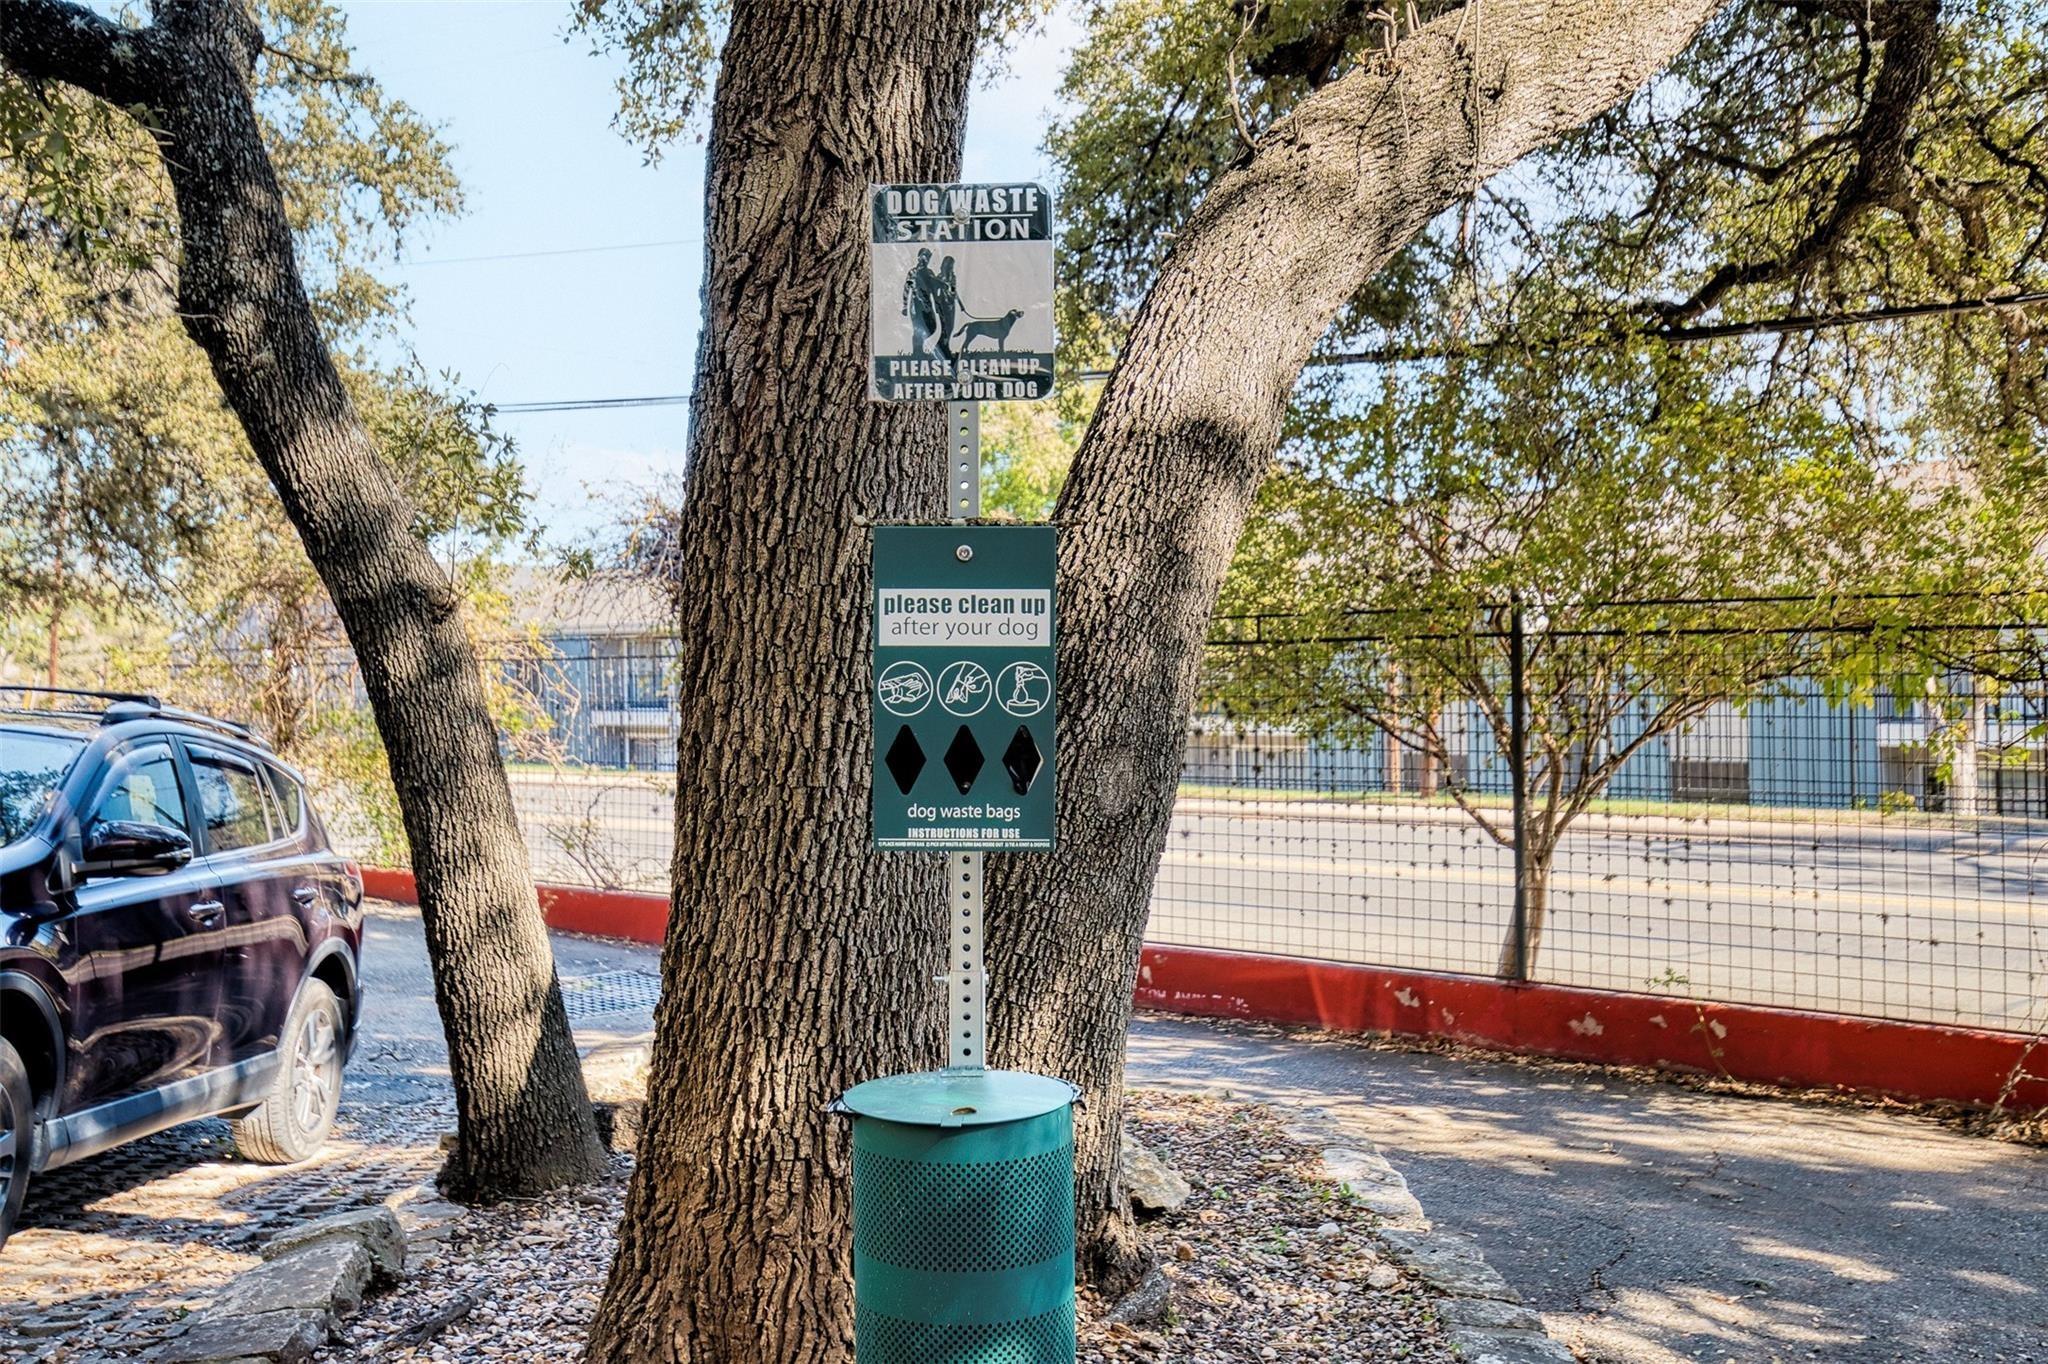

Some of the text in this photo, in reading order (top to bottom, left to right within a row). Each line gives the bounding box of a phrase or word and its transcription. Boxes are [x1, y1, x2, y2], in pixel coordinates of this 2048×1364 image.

[886, 187, 1039, 215] DOG WASTE
[896, 217, 1030, 241] STATION
[889, 357, 1041, 378] PLEASE CLEAN UP
[893, 380, 1038, 400] AFTER YOUR DOG
[884, 594, 1046, 616] please clean up
[891, 616, 1039, 640] after your dog
[907, 803, 1021, 822] dog waste bags
[908, 828, 1020, 839] INSTRUCTIONS FOR USE
